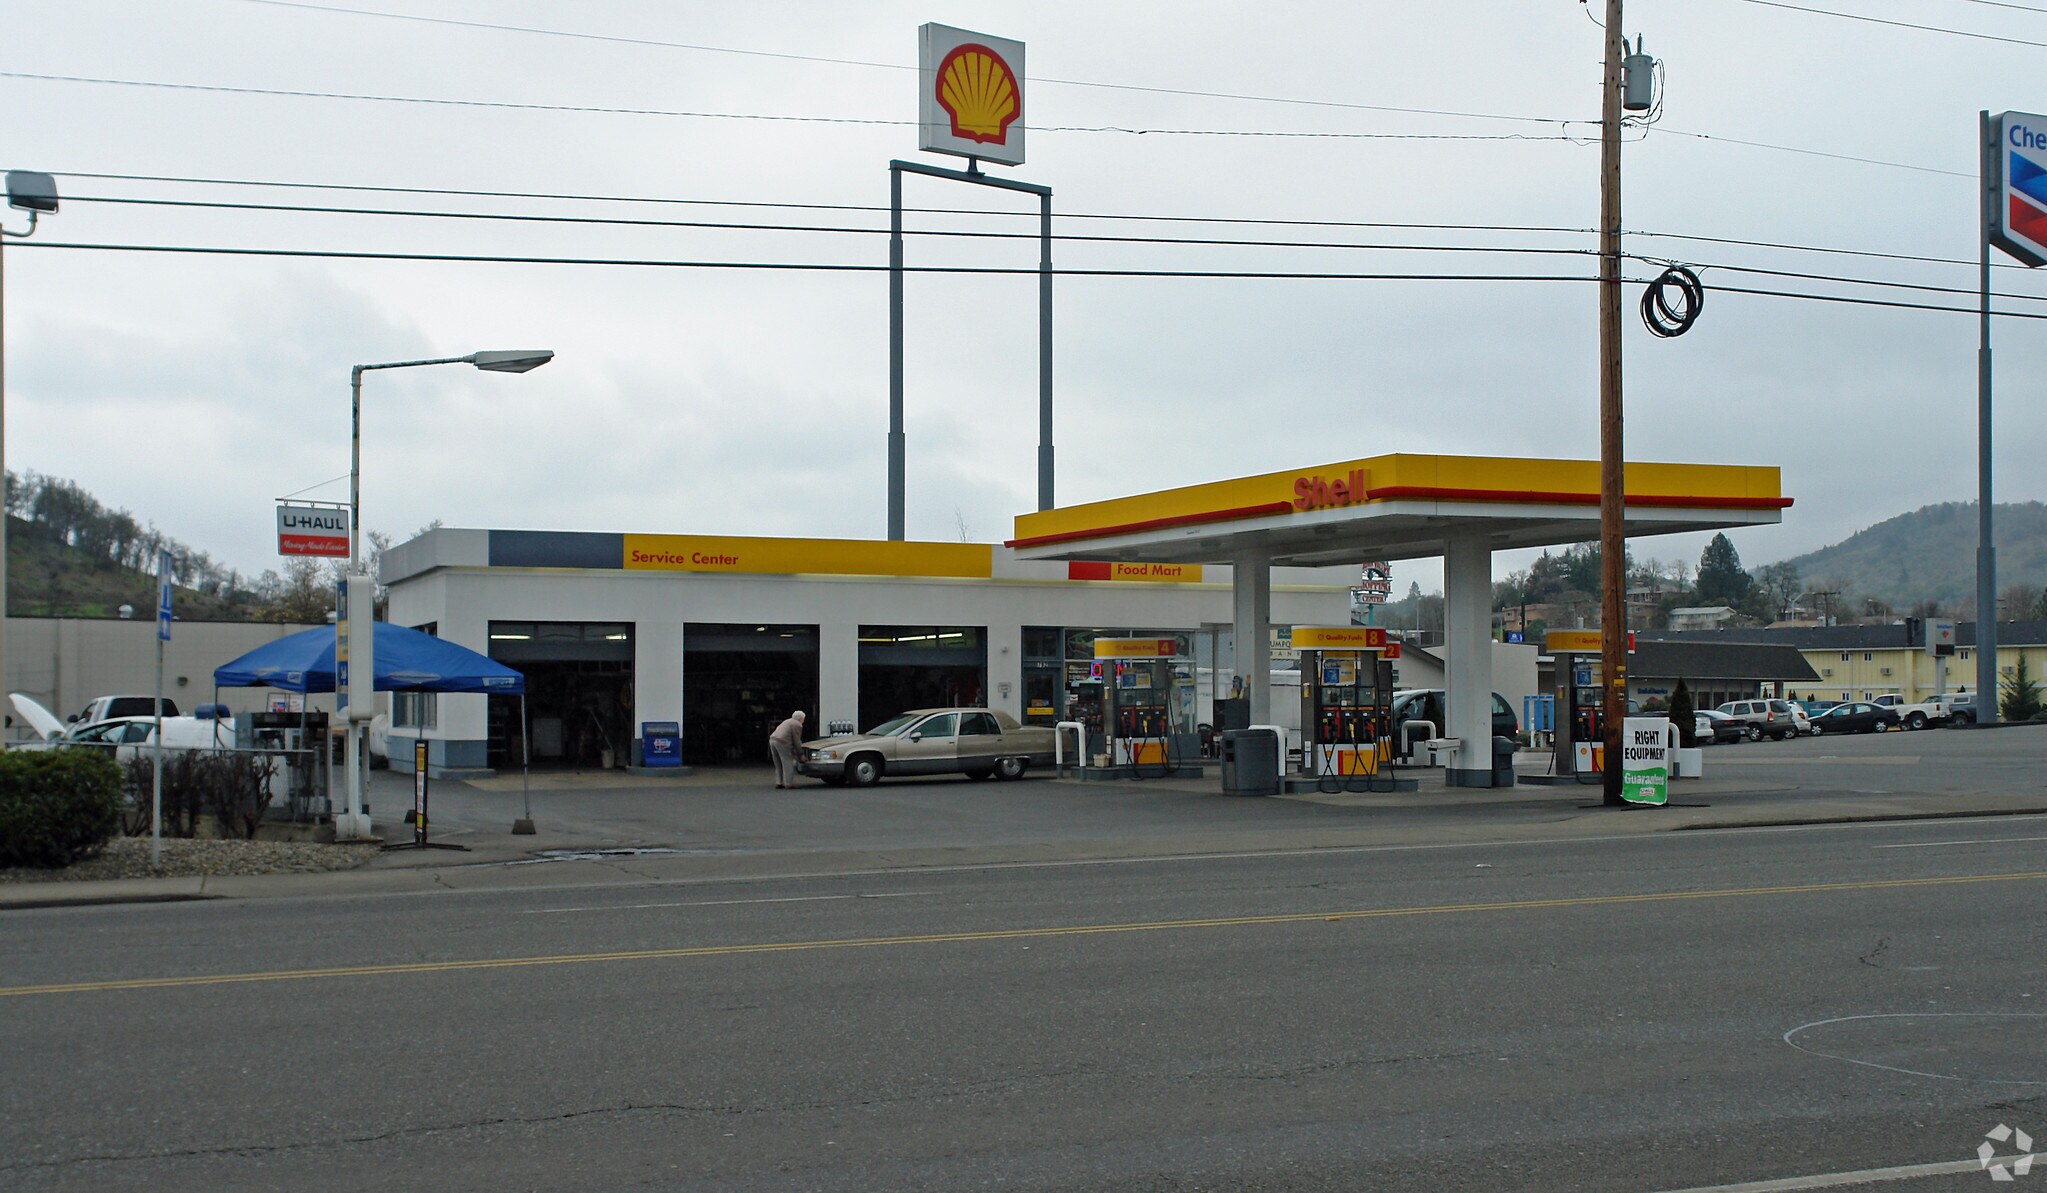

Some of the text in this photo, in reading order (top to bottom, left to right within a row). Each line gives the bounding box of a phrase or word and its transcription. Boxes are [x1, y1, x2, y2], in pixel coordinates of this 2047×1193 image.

[1293, 468, 1366, 510] Shell
[283, 515, 344, 530] U-HAUL
[632, 550, 739, 566] Service Center
[1117, 563, 1182, 576] Food Mart
[1369, 631, 1379, 645] 8
[1160, 641, 1170, 653] 4
[1387, 645, 1395, 657] 2
[1635, 731, 1659, 745] RIGHT
[1625, 748, 1665, 760] EQUIPMENT
